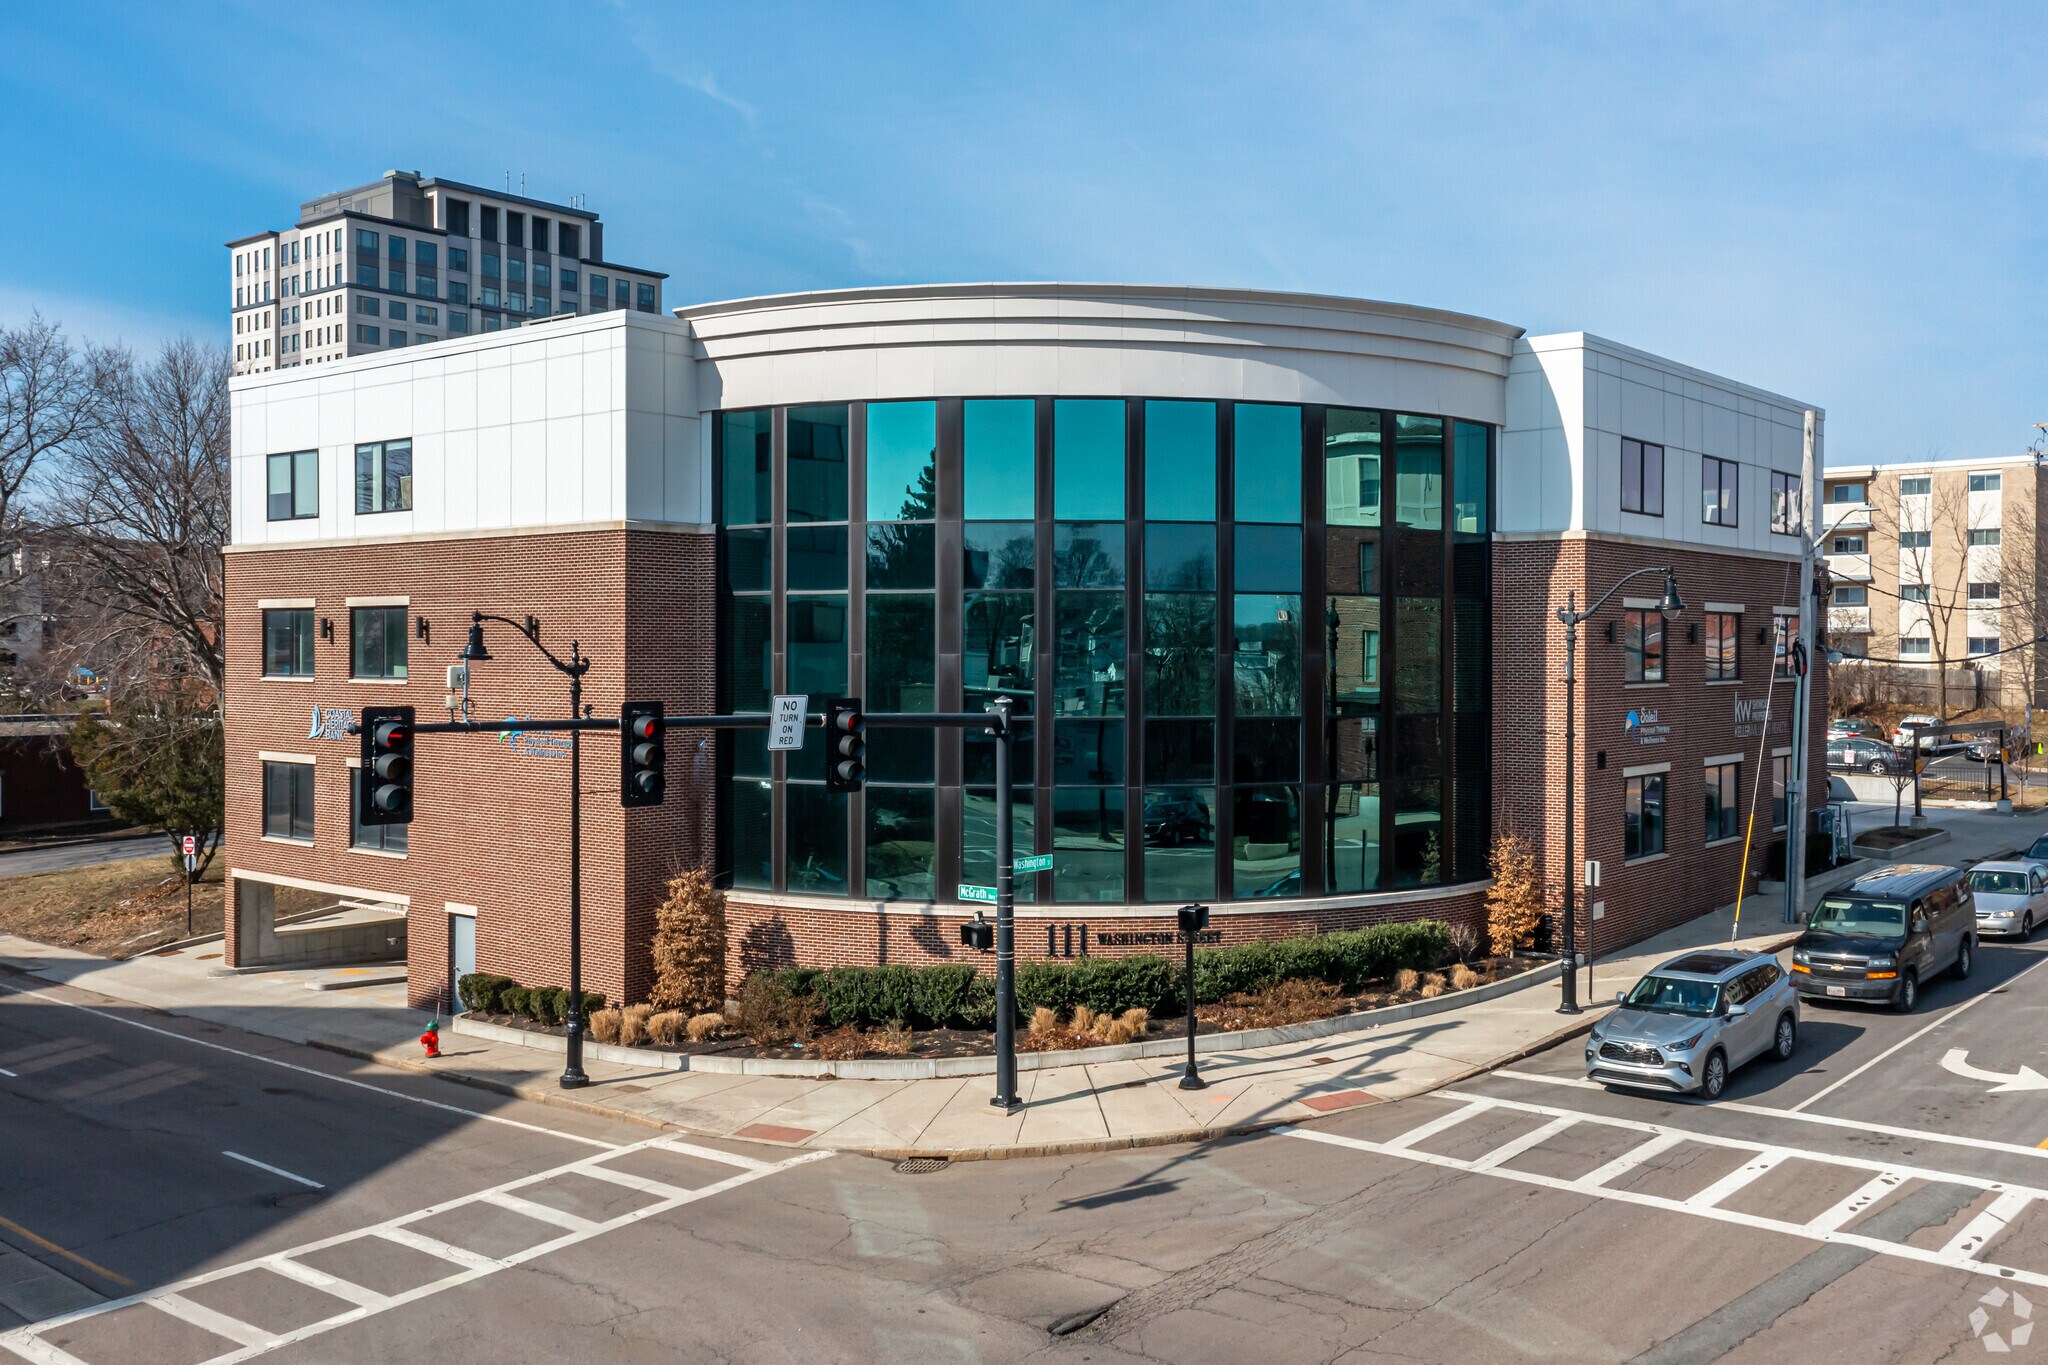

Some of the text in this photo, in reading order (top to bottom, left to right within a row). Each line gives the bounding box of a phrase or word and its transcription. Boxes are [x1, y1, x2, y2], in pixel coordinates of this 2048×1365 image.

[783, 701, 797, 710] NO
[325, 708, 353, 719] COASTAL
[780, 714, 798, 722] TURN
[1640, 707, 1658, 723] Soleil
[326, 730, 345, 740] BANK
[524, 737, 572, 748] Physical Therapy
[530, 748, 556, 757] Wellness
[1013, 857, 1046, 870] Washington
[960, 887, 986, 899] McGrath
[1045, 923, 1221, 957] 111 WASHINGTON SEET
